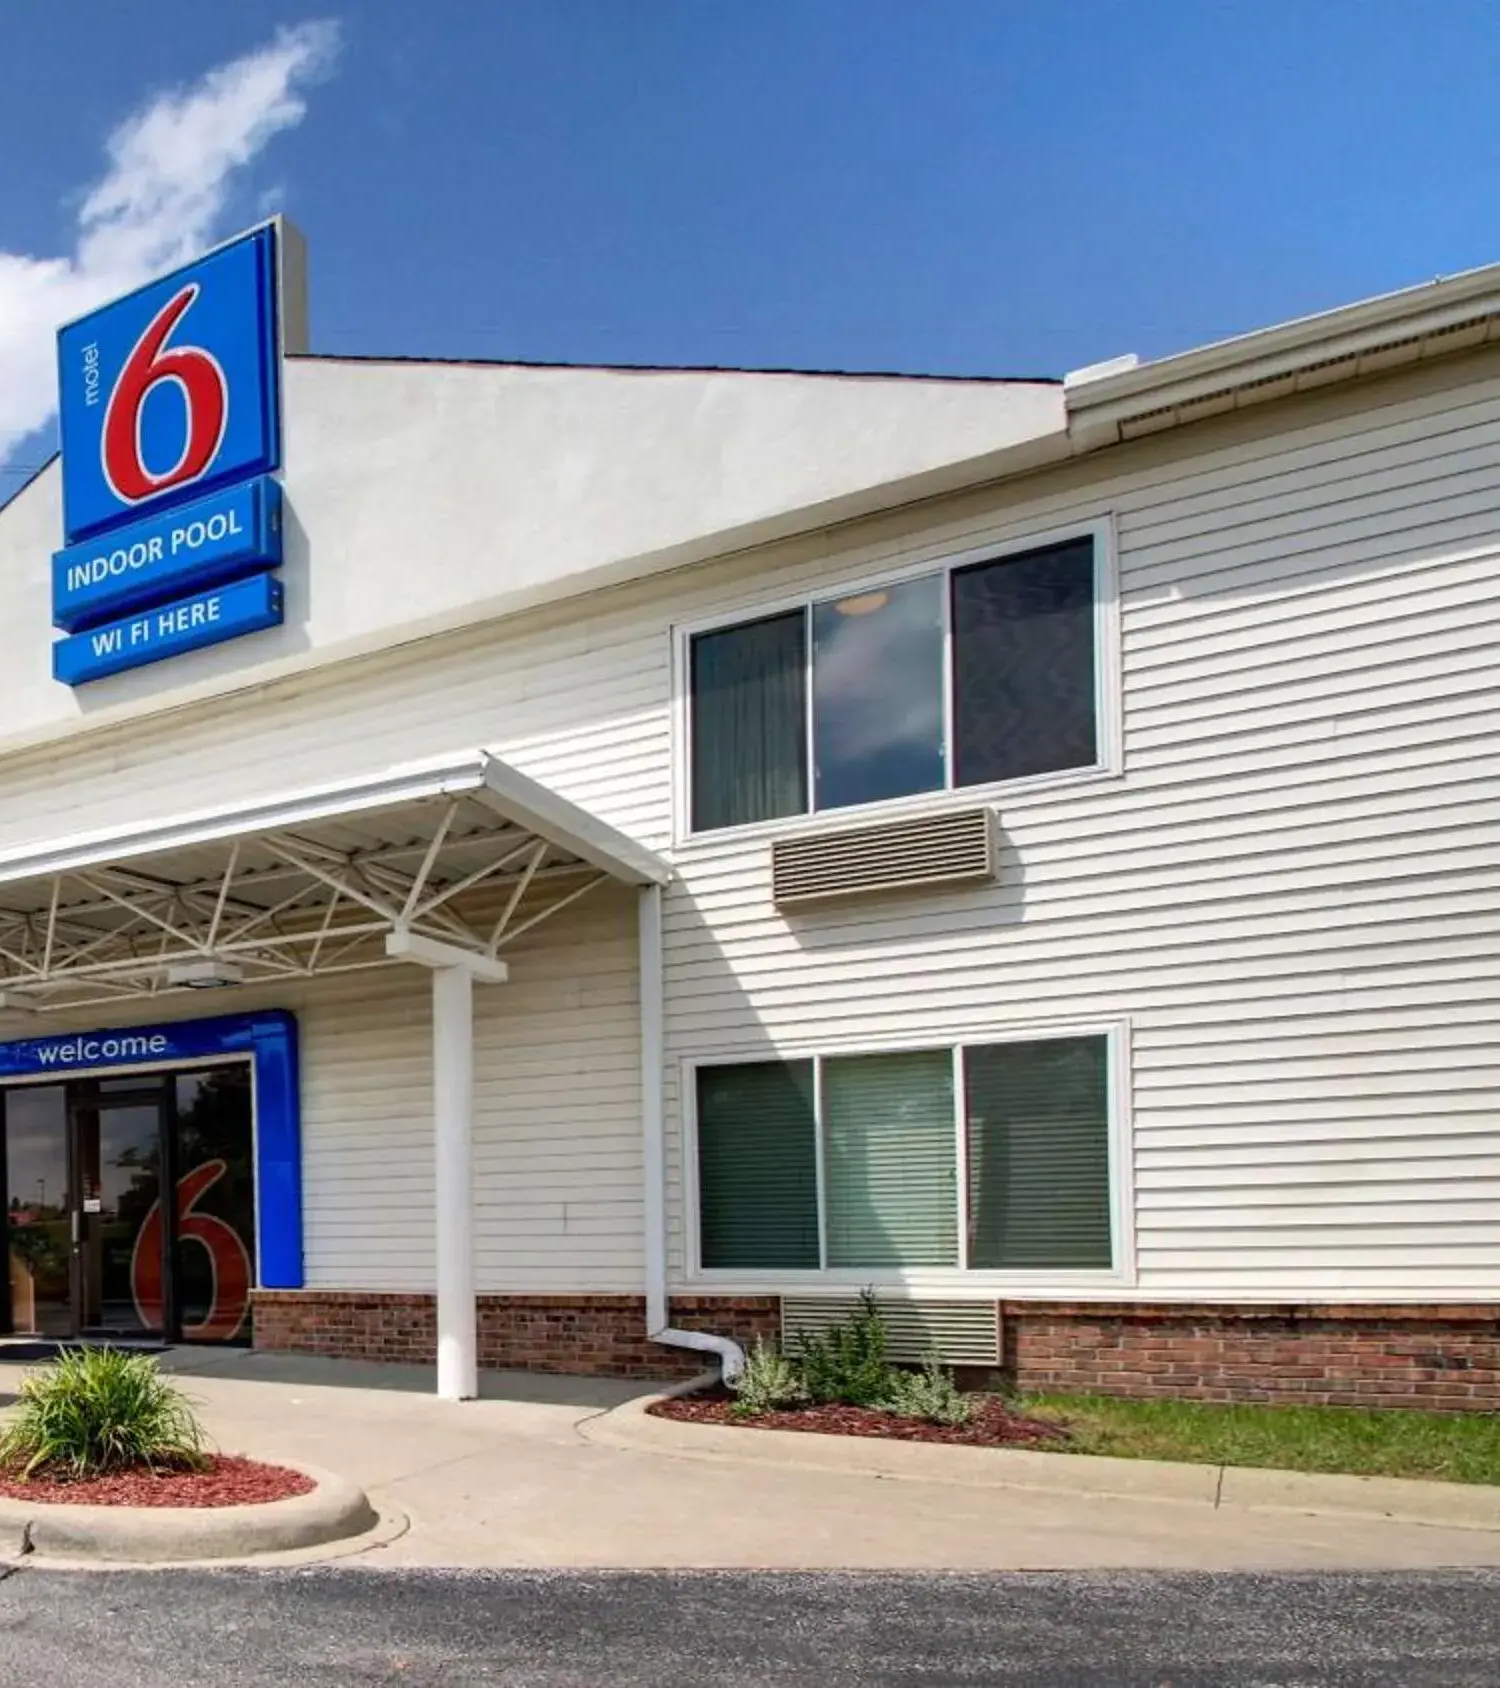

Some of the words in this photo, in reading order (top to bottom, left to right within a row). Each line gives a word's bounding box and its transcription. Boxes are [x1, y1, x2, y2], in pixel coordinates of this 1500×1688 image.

[82, 341, 99, 406] motel
[101, 282, 228, 506] 6
[67, 537, 163, 591] INDOOR
[171, 509, 242, 554] POOL
[92, 628, 121, 657] WI
[131, 620, 149, 645] FI
[158, 597, 220, 636] HERE
[38, 1034, 167, 1065] welcome
[131, 1159, 252, 1340] 6
